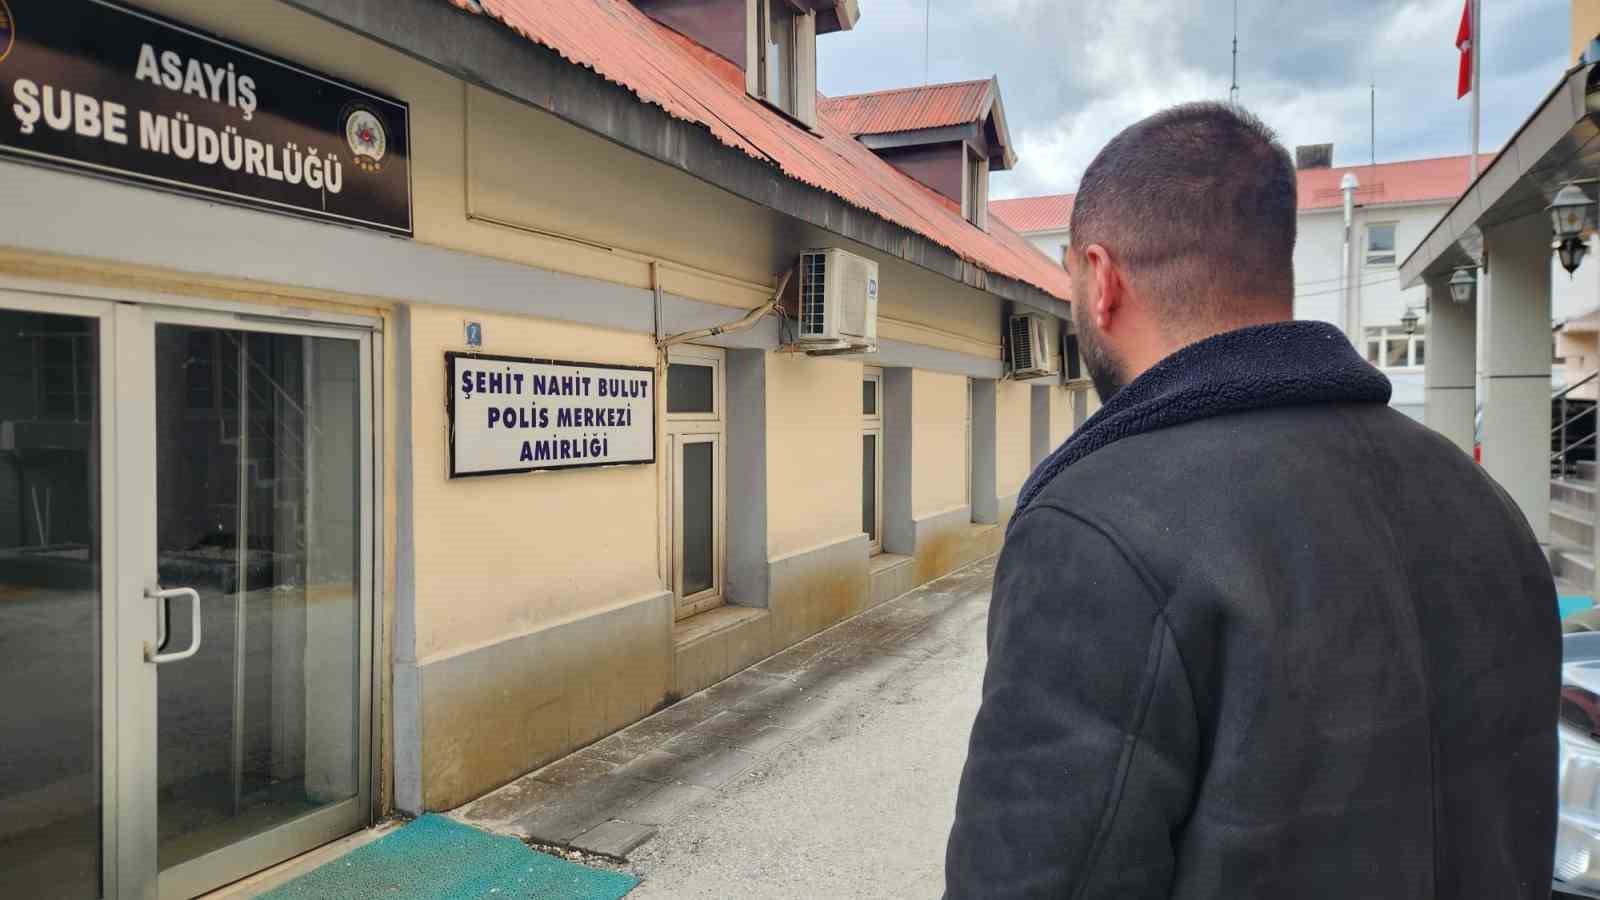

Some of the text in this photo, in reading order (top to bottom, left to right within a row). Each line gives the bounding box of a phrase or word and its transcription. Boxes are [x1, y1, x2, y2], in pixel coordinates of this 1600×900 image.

[135, 43, 257, 120] ASAYİŞ
[13, 79, 342, 193] ŞUBE MÜDÜRLÜĞÜ
[462, 366, 648, 399] ŞEHİT NAHİT BULUT
[488, 401, 631, 428] POLİS MERKEZİ
[520, 432, 608, 461] AMİRLİĞİ
